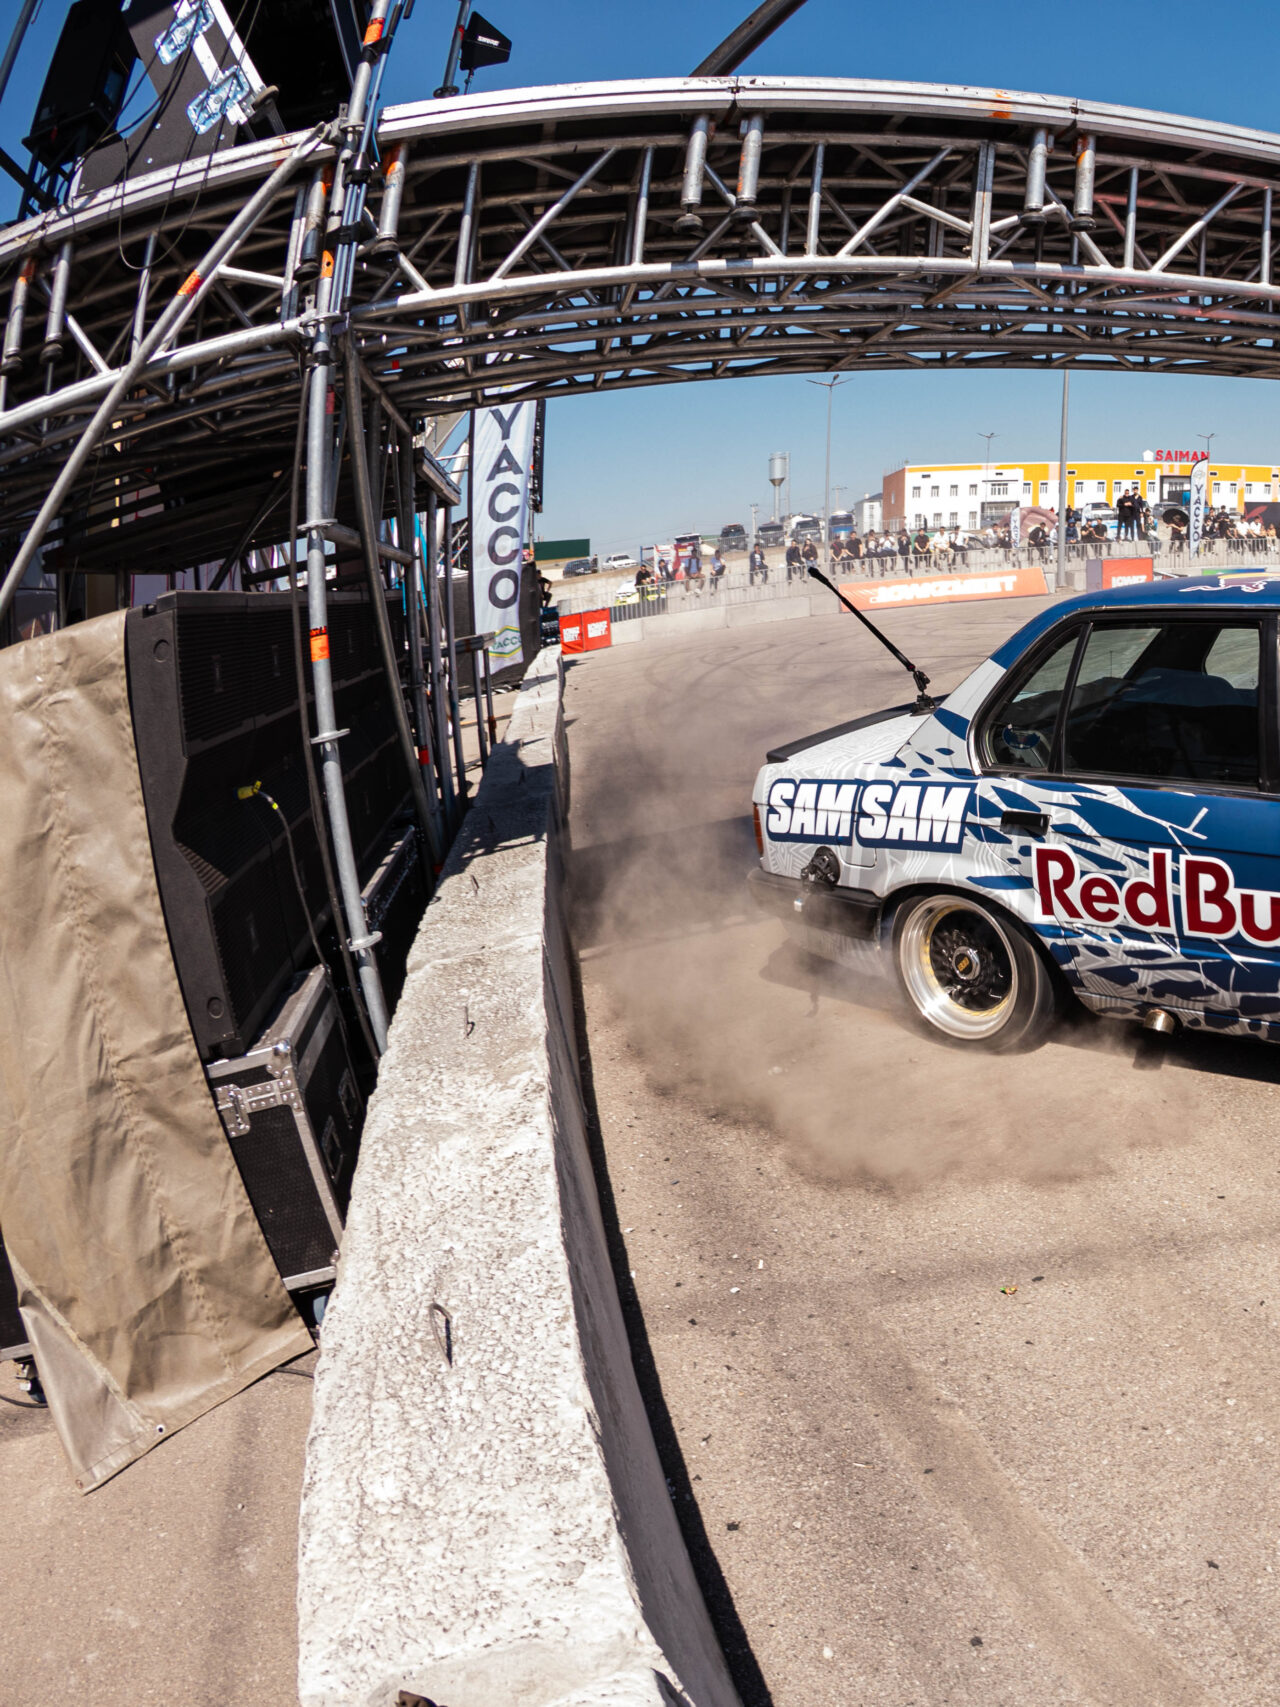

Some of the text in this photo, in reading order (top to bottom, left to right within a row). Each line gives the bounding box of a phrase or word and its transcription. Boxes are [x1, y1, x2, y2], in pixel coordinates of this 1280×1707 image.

[1155, 450, 1210, 462] SAIMAN
[486, 401, 524, 609] YACCO
[1193, 484, 1204, 542] YACCO
[1035, 846, 1172, 929] Red
